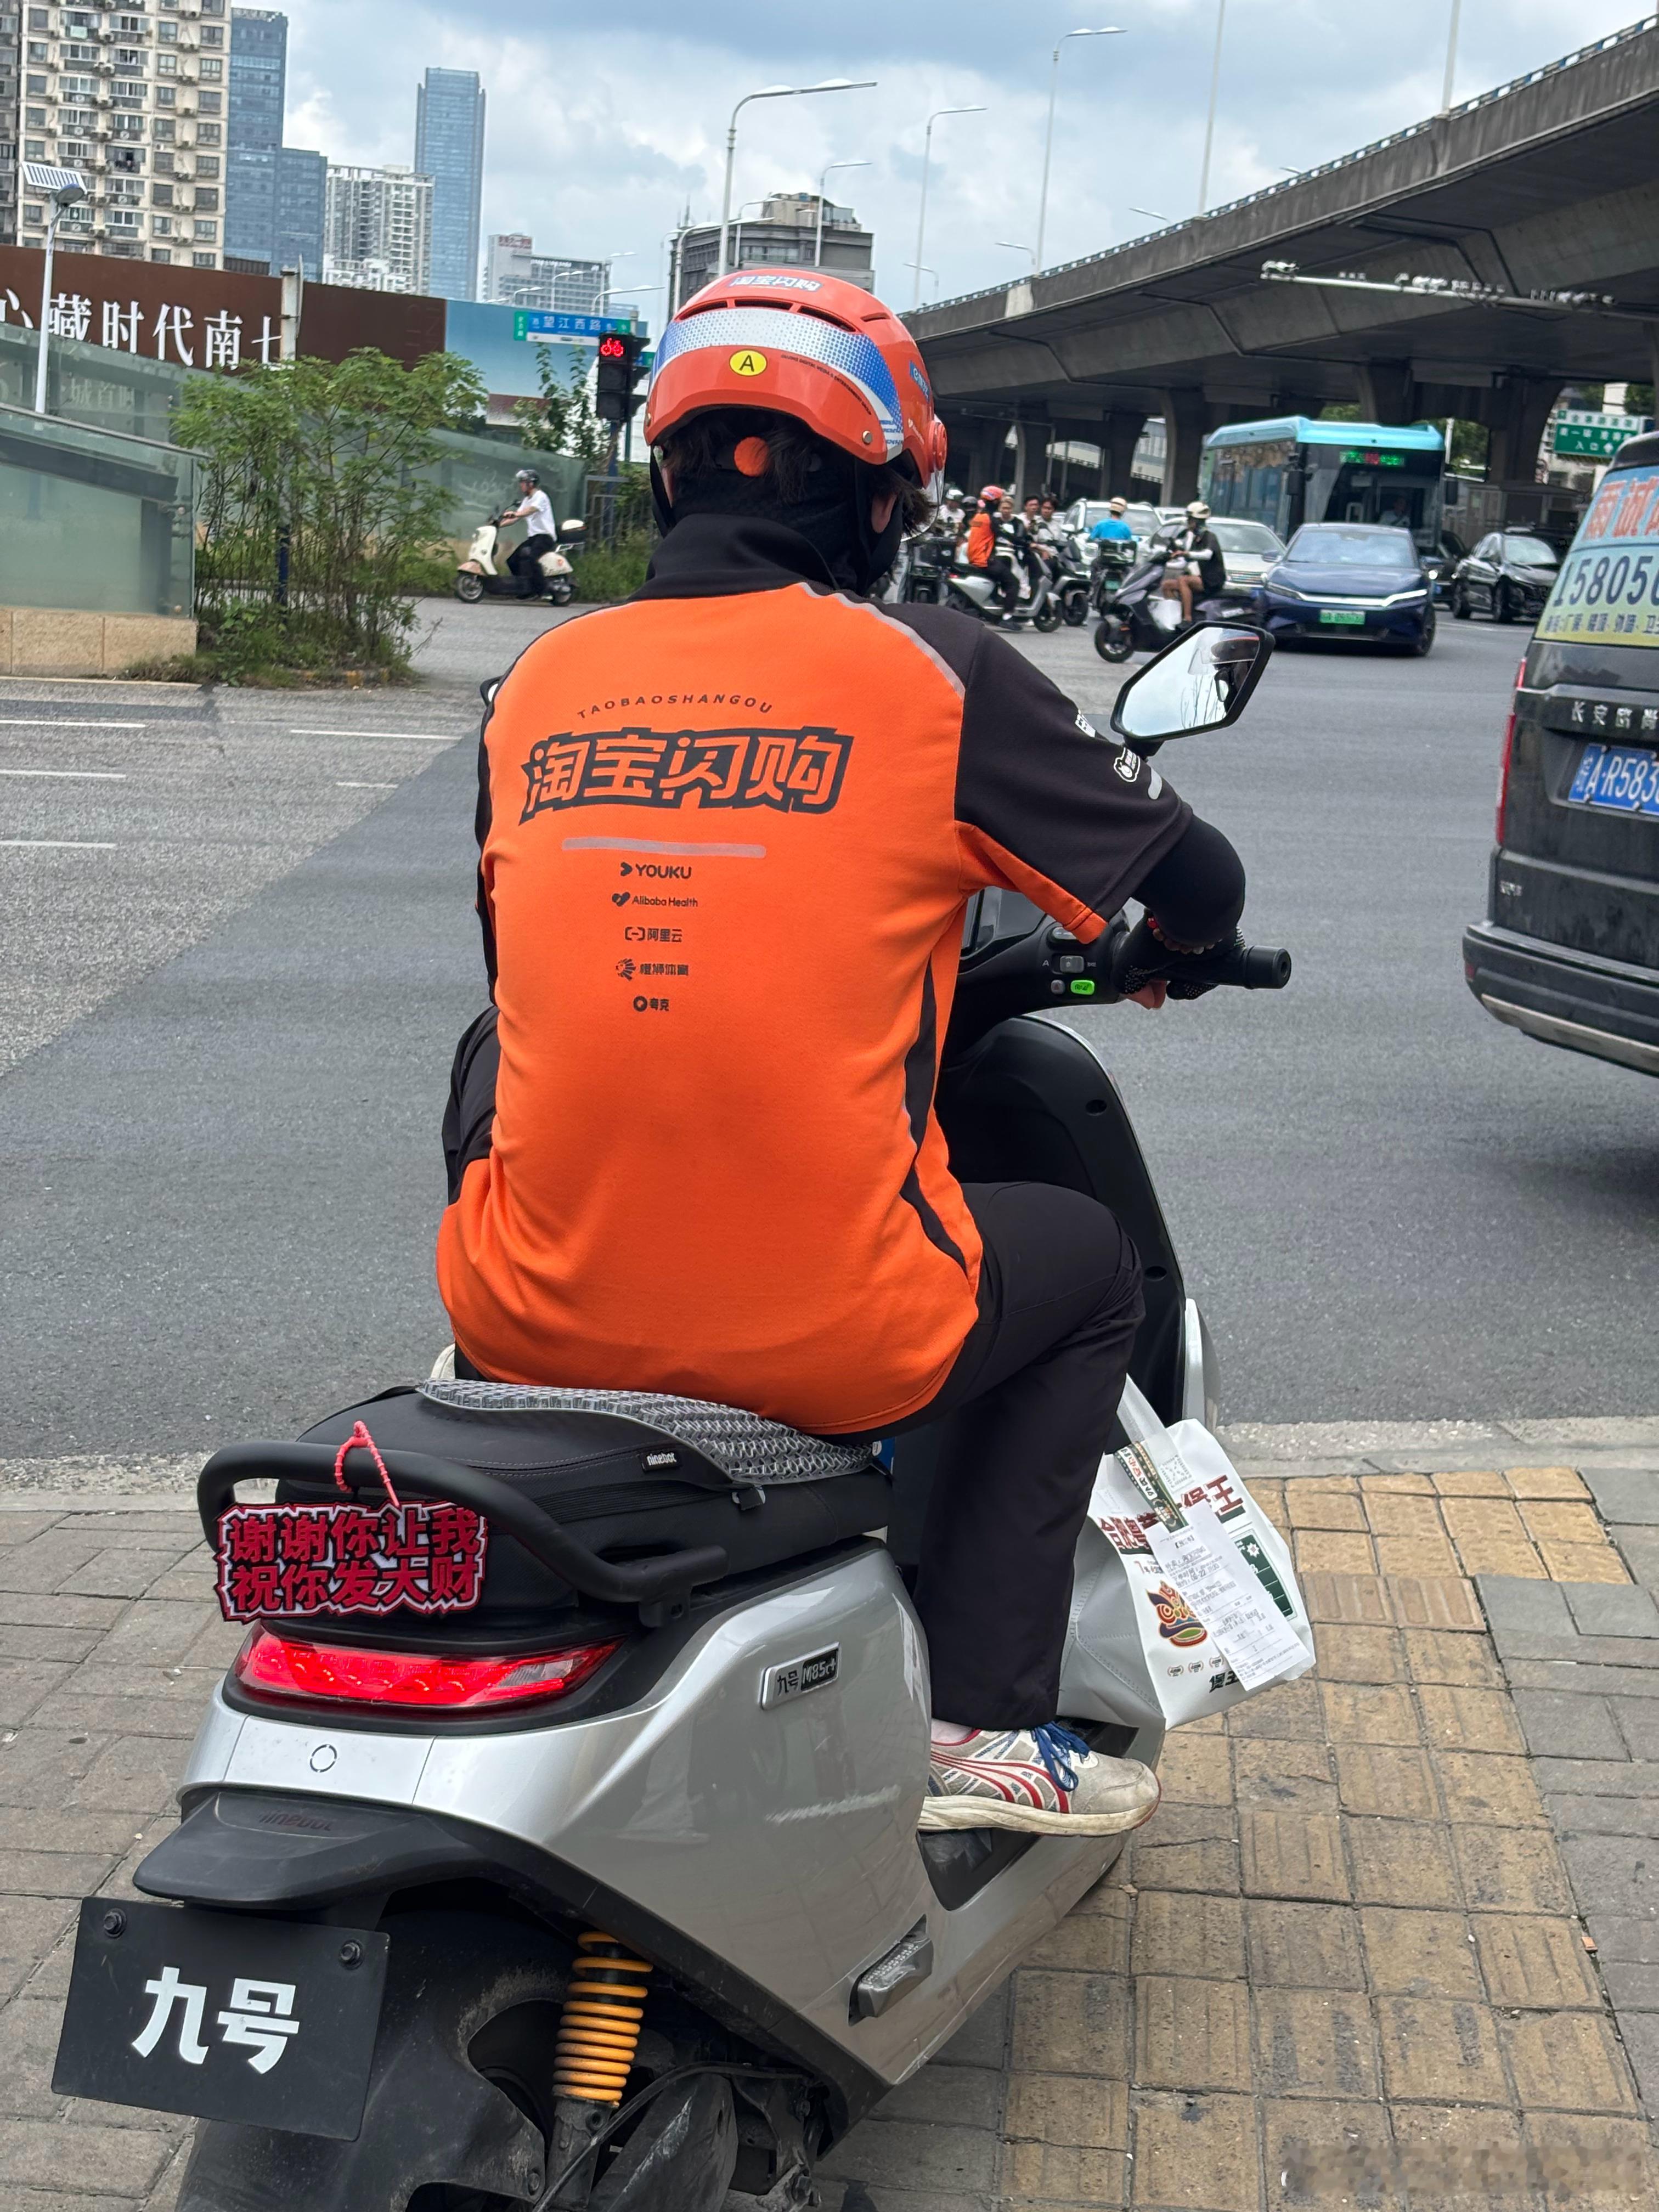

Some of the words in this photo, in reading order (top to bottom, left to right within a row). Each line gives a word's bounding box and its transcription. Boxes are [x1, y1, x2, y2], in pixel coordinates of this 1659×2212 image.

[729, 275, 821, 291] 淘宝闪购
[543, 315, 601, 331] 望江西路
[740, 354, 755, 373] A
[578, 693, 772, 719] TAOBAOSHANGOU
[522, 729, 852, 822] 淘宝闪购
[635, 864, 692, 879] YOUKU
[632, 895, 667, 906] Alibaba
[668, 897, 698, 907] Health
[647, 928, 682, 943] 阿里云
[640, 963, 689, 976] 橙狮体育
[649, 997, 670, 1011] 夸克
[646, 1452, 678, 1466] ninebot
[229, 1506, 479, 1564] 谢谢你让我
[230, 1555, 479, 1611] 祝你发大财
[776, 1669, 799, 1696] 九号
[131, 1966, 300, 2075] 九号
